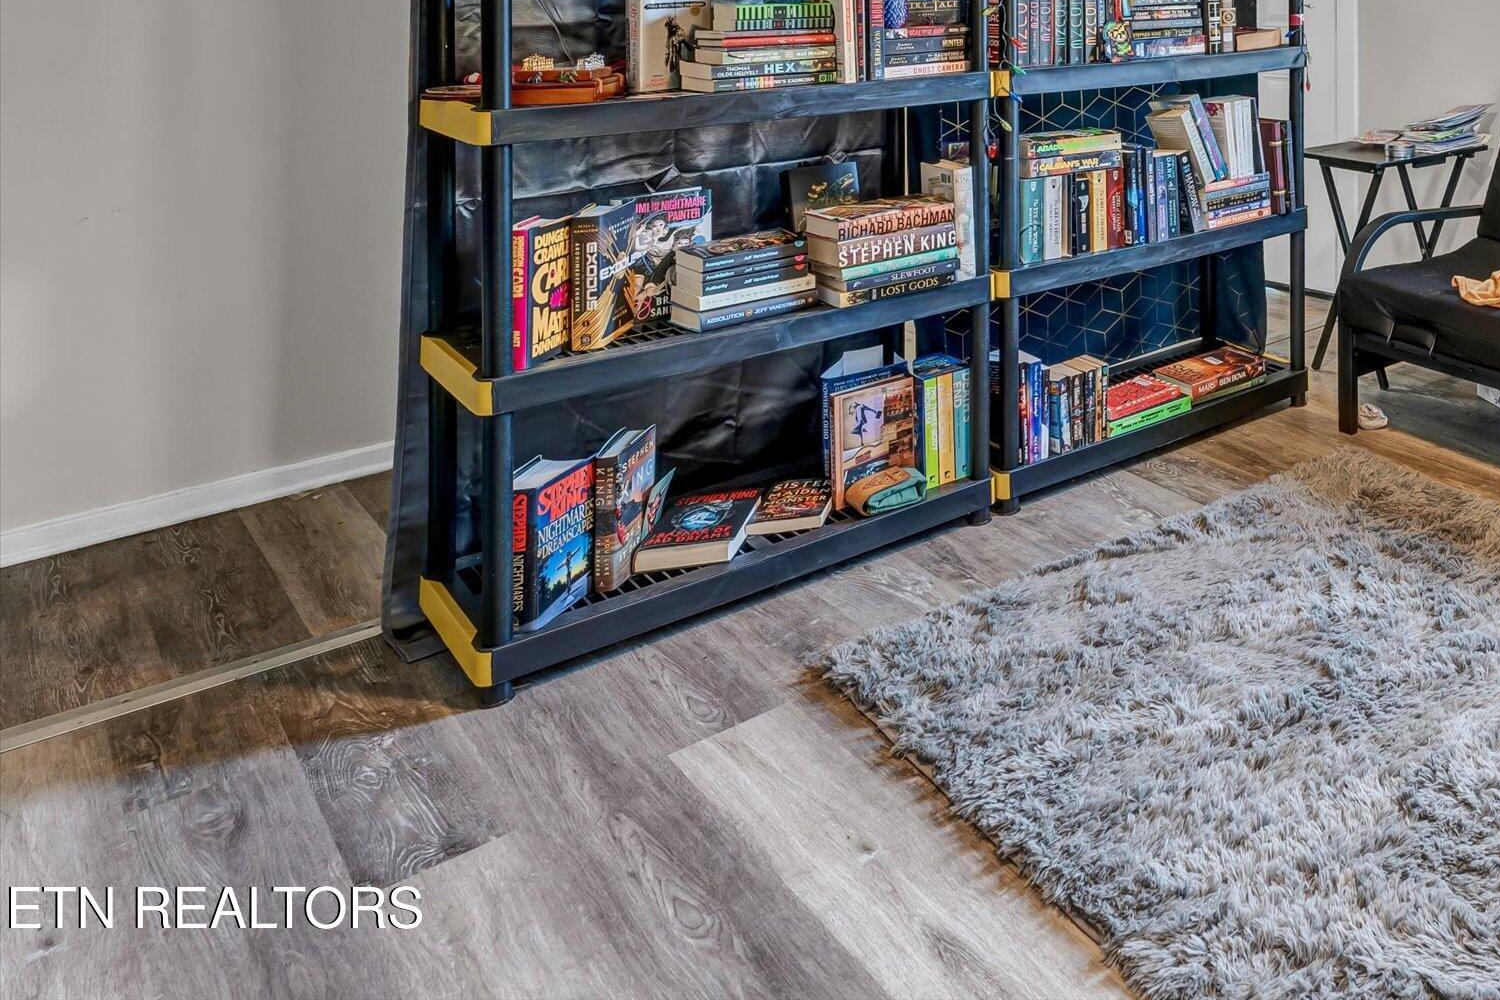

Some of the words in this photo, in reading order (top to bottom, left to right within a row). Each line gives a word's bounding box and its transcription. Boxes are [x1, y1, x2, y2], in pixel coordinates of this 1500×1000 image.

[871, 0, 883, 27] KOONTZ
[934, 0, 959, 10] TALE
[764, 63, 796, 74] HEX
[937, 64, 964, 72] CAMERA
[661, 196, 706, 211] NIGHTMARE
[668, 208, 701, 221] PAINTER
[839, 220, 893, 240] RICHARD
[897, 208, 955, 229] BACHMAN
[534, 226, 569, 251] DUNGEO
[839, 239, 914, 267] STEPHEN
[920, 231, 956, 251] KING
[586, 242, 598, 311] EXODUS
[891, 266, 937, 280] SLEWFOOT
[705, 283, 728, 291] Authority
[880, 284, 907, 297] LOST
[909, 277, 939, 291] GODS
[707, 312, 744, 325] ABSOLUTION
[754, 307, 768, 315] JEFF
[1198, 382, 1216, 393] MARS
[1219, 378, 1231, 387] BEN
[1232, 371, 1247, 382] BOVA
[954, 382, 962, 408] END
[622, 441, 655, 473] STEPHEN
[537, 462, 594, 516] STEPHEN
[596, 468, 604, 506] KING
[768, 488, 831, 499] MAIDEN
[773, 479, 832, 491] SISTER
[550, 487, 588, 521] KING
[676, 492, 730, 506] STEPHEN
[731, 488, 758, 500] KING
[762, 495, 827, 506] MONSTER
[538, 498, 594, 545] NIGHTMARES
[513, 554, 524, 612] NIGHTMARES
